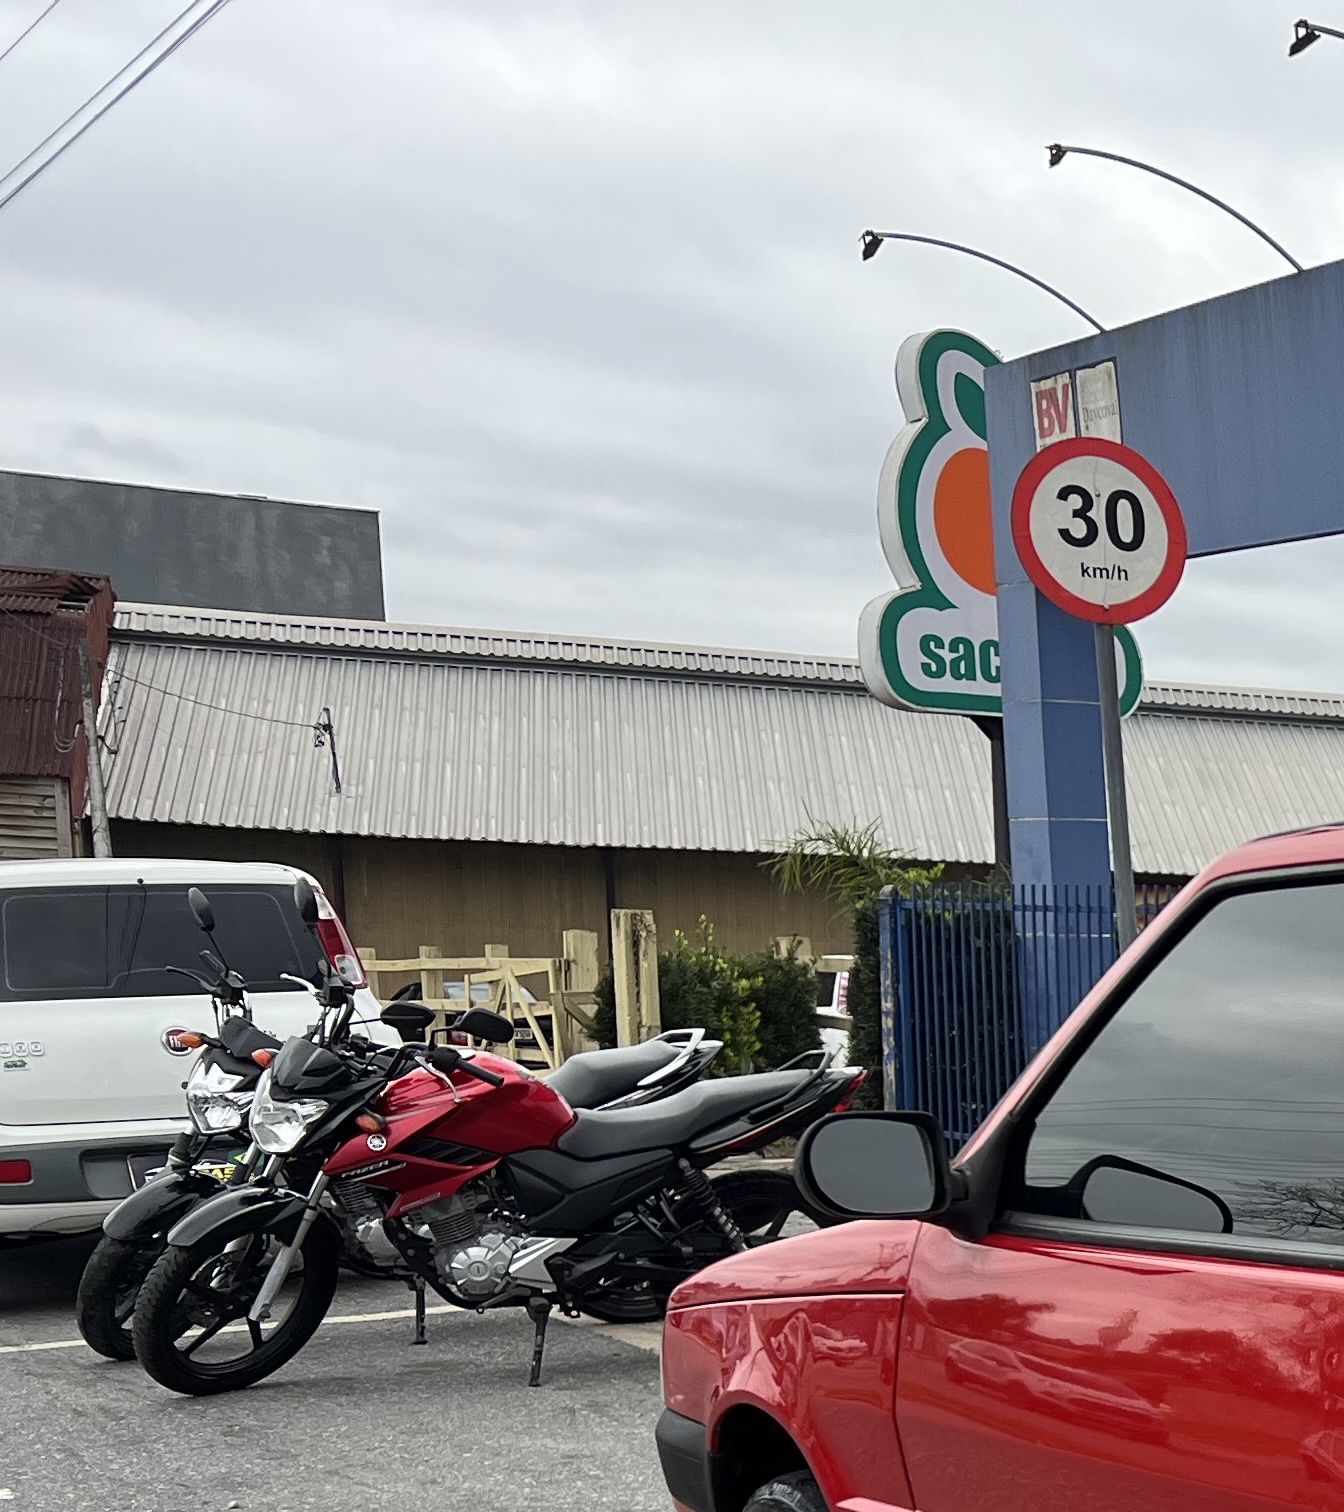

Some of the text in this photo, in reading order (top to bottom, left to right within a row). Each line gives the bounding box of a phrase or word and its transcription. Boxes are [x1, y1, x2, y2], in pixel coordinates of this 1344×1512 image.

[1035, 382, 1070, 439] BV
[1056, 484, 1146, 552] 30
[1080, 563, 1129, 582] km/h
[919, 633, 1001, 683] sac
